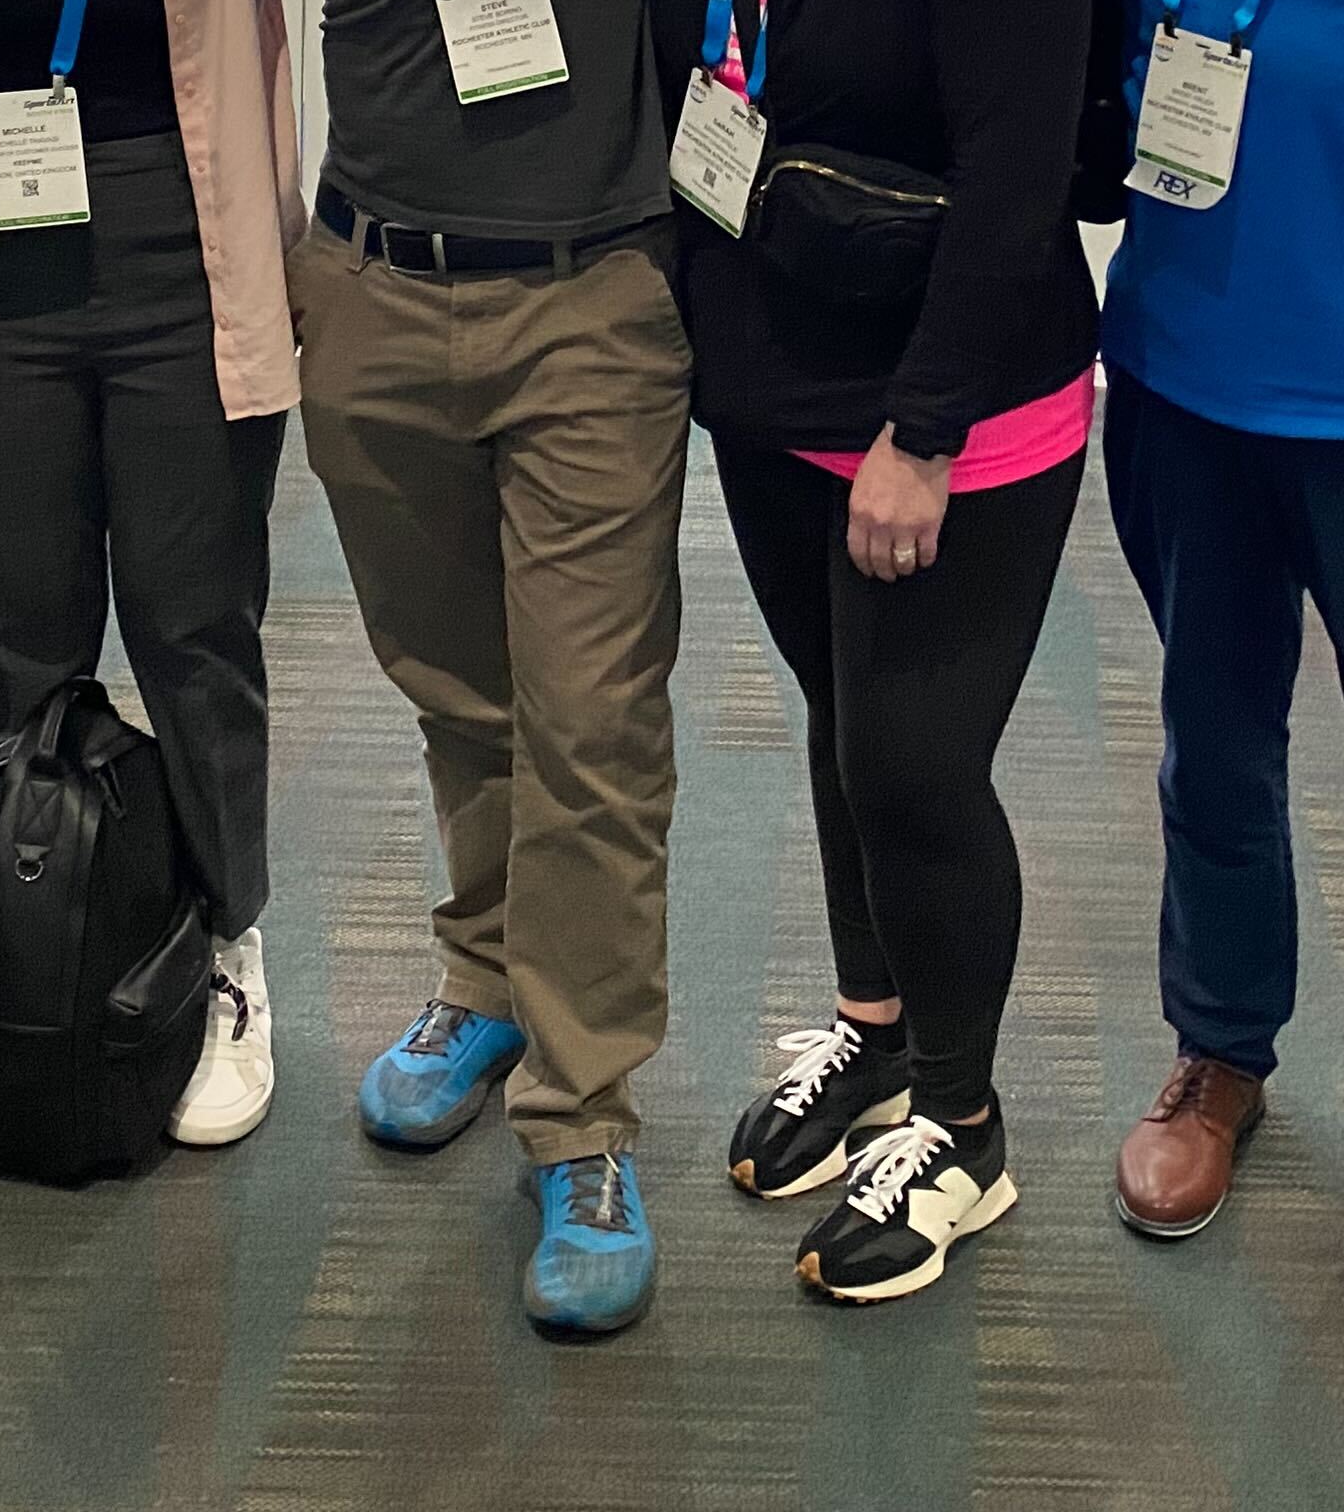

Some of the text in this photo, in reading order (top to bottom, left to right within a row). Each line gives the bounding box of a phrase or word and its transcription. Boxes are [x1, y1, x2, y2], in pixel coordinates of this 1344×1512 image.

[480, 0, 508, 13] STEVE
[2, 124, 47, 136] MICHELLE
[1153, 169, 1197, 200] REX
